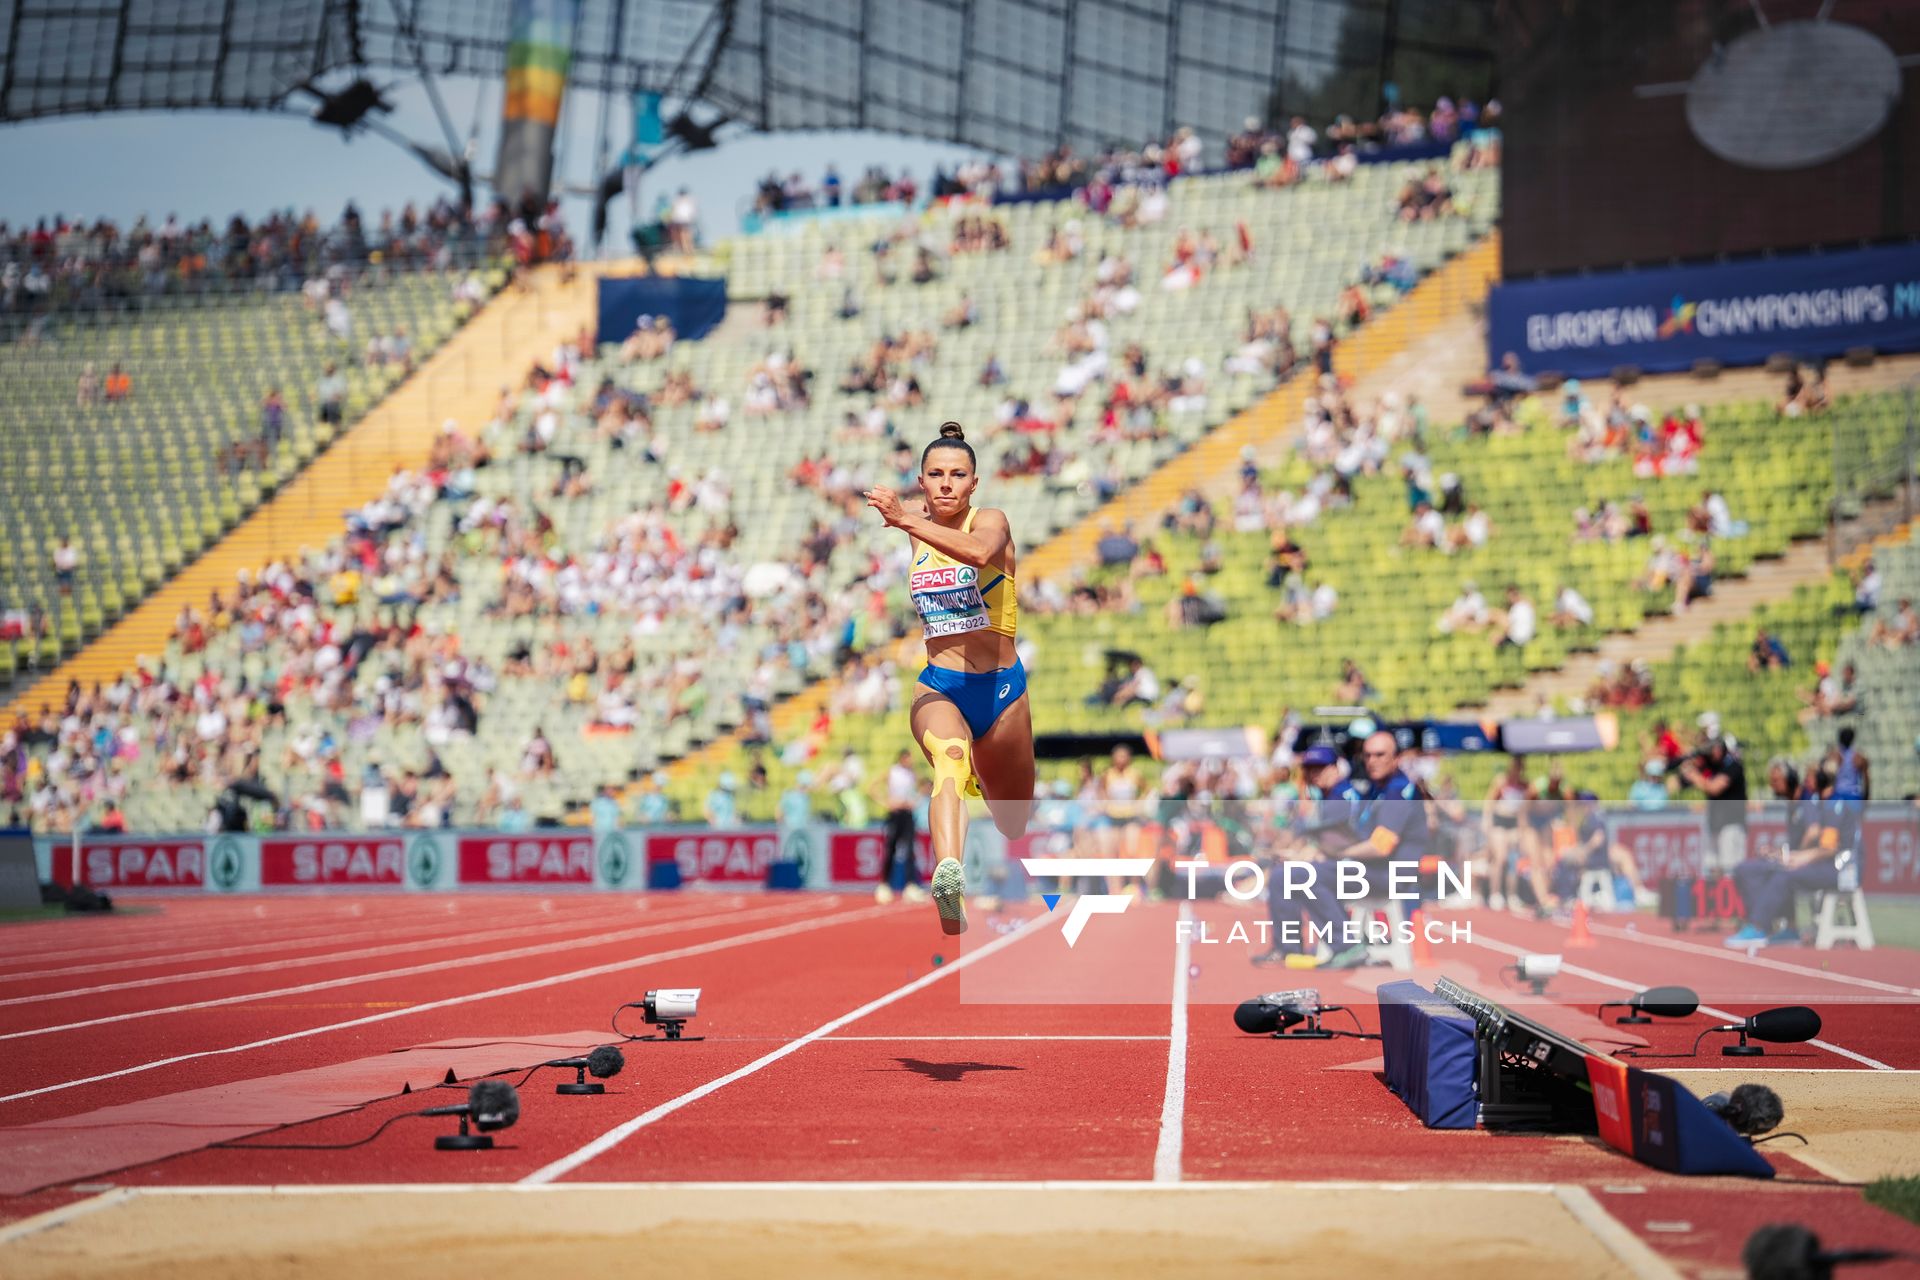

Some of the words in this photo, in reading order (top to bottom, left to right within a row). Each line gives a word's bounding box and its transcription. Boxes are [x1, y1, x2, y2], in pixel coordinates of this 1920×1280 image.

[1527, 306, 1657, 351] EUROPEAN
[1695, 285, 1887, 337] CHAMPIONSHIPS
[1894, 281, 1920, 319] M
[911, 570, 955, 588] SPAR
[960, 617, 985, 630] 2022
[87, 847, 203, 884] SPAR
[293, 844, 402, 881] SPAR
[487, 841, 592, 878] SPAR
[675, 839, 776, 877] SPAR
